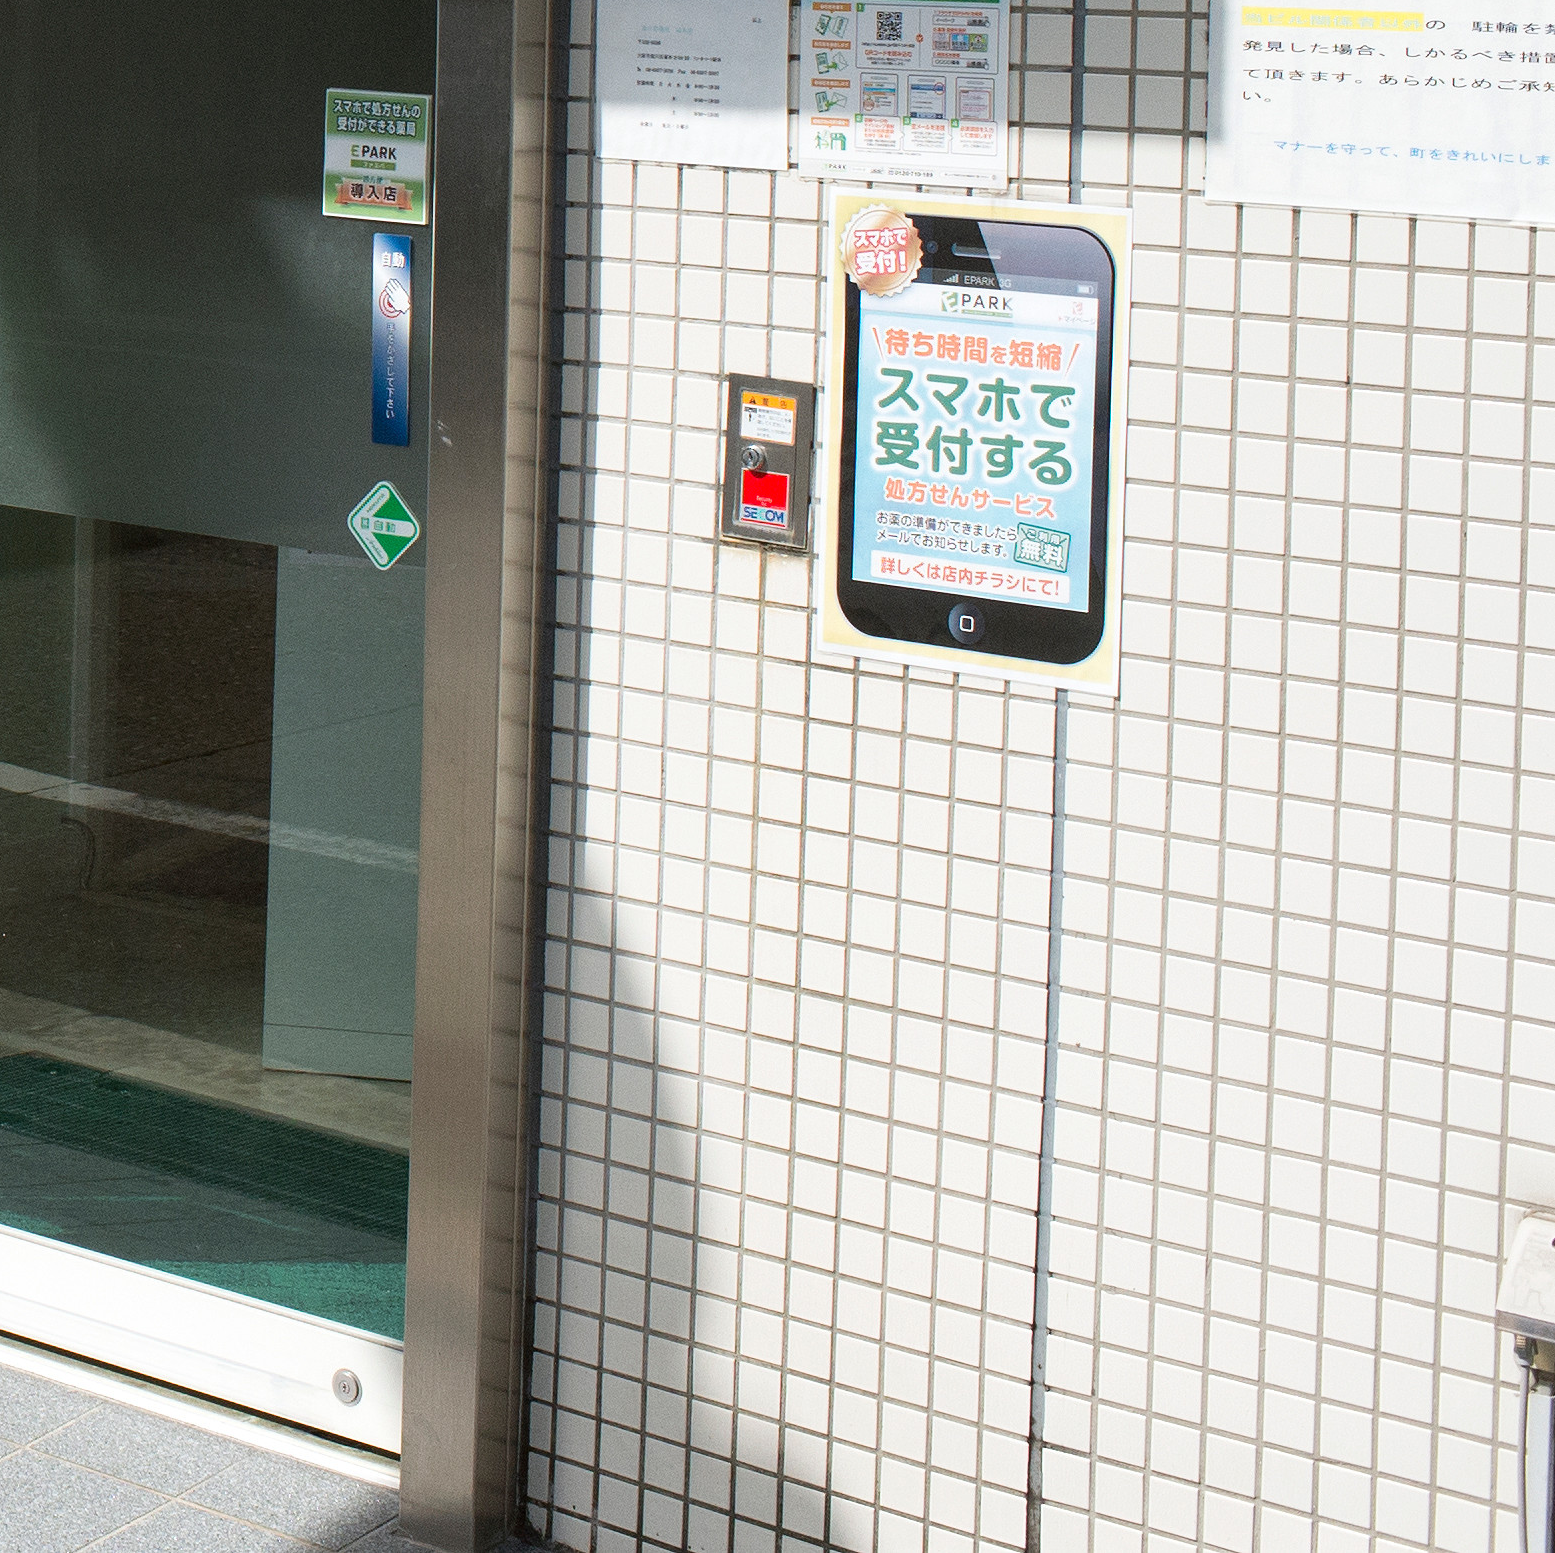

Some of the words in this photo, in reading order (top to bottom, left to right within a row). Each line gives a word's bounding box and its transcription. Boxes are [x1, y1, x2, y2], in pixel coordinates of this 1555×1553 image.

[333, 99, 422, 119] スマホで処方せんの
[337, 116, 416, 137] 受付ができる薬局
[351, 144, 397, 161] EPARK
[350, 183, 397, 202] 導入店
[854, 227, 908, 249] スマホで
[381, 251, 406, 269] 自動
[963, 274, 996, 288] EPARK
[885, 328, 1062, 371] 待ち時間を短縮
[878, 367, 1076, 429] スマホで
[875, 421, 1073, 486] 受付する
[885, 477, 1056, 518] 処方せんサービス
[744, 506, 784, 523] SECOM
[876, 512, 1018, 542] お薬の準備ができましたら
[876, 529, 1008, 558] メールでお知らせします。
[1019, 539, 1065, 567] 無料
[880, 556, 1060, 596] 詳しくは店内チラシにて!
